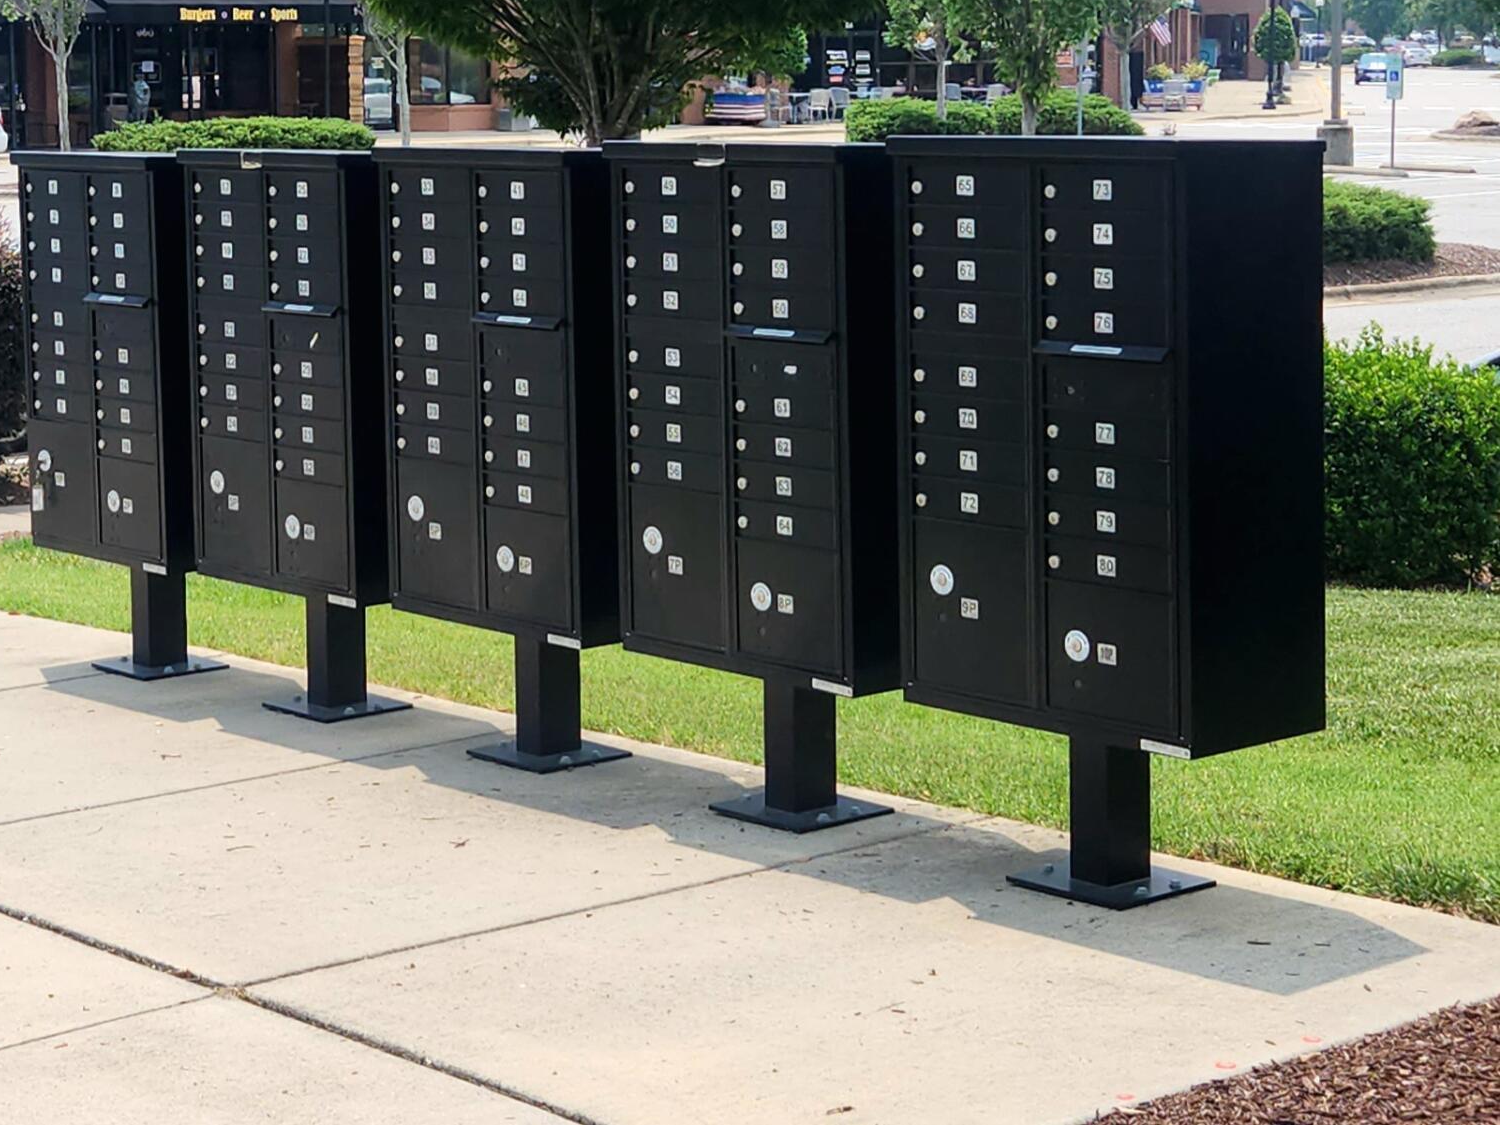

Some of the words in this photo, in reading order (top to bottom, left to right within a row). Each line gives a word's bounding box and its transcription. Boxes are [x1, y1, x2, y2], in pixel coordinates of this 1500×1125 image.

[179, 7, 216, 22] Burgers
[232, 7, 254, 21] Beer
[270, 7, 298, 23] Sports
[663, 179, 674, 192] 49
[772, 183, 784, 196] 57
[958, 178, 972, 192] 65
[1095, 182, 1110, 197] 73
[664, 217, 676, 230] 50
[773, 222, 785, 236] 58
[958, 221, 973, 235] 66
[1096, 226, 1110, 240] 74
[664, 255, 676, 268] 51
[774, 262, 786, 275] 59
[959, 263, 974, 278] 67
[1096, 271, 1111, 286] 75
[665, 293, 676, 307] 52
[774, 302, 787, 315] 60
[960, 306, 974, 320] 68
[1096, 315, 1112, 330] 76
[666, 350, 678, 364] 53
[960, 370, 974, 384] 69
[667, 388, 679, 400] 54
[776, 401, 788, 414] 61
[961, 411, 975, 426] 70
[667, 426, 679, 440] 55
[1097, 425, 1112, 441] 77
[776, 440, 789, 453] 62
[961, 453, 975, 467] 71
[668, 464, 680, 477] 56
[1098, 470, 1113, 485] 78
[777, 479, 790, 493] 63
[963, 495, 976, 510] 72
[778, 518, 791, 533] 64
[1099, 514, 1114, 528] 79
[669, 558, 682, 571] 7P
[1099, 558, 1114, 574] 80
[778, 597, 792, 610] 8P
[961, 600, 977, 614] 9P
